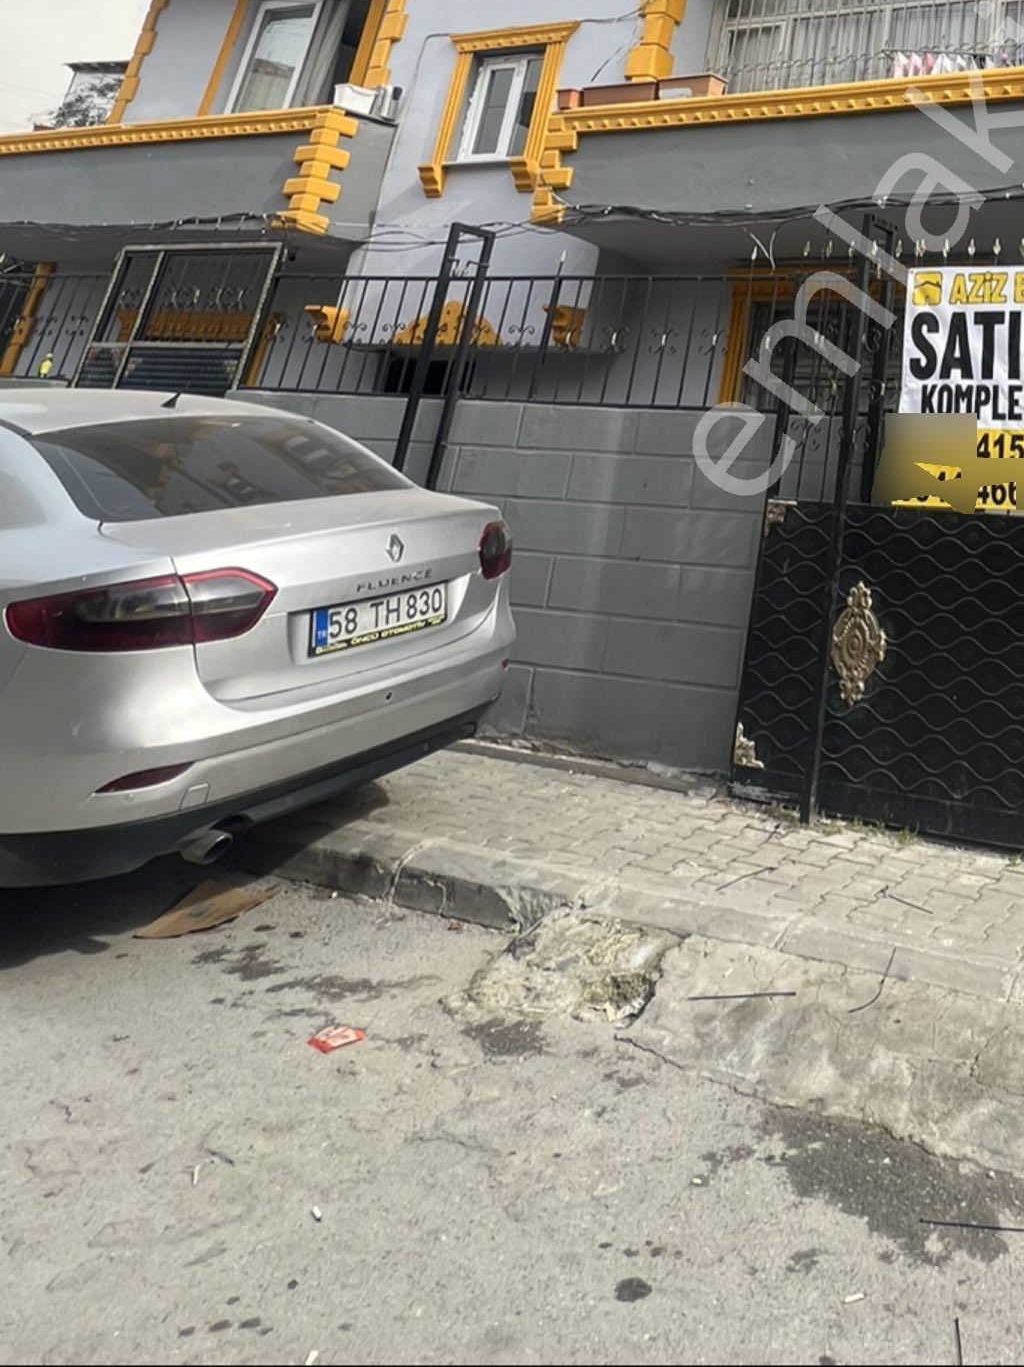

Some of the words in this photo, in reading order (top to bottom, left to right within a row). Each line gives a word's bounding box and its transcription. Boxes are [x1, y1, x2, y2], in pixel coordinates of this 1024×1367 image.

[920, 384, 1023, 421] KOMPLE
[977, 433, 1024, 458] 415
[356, 568, 432, 592] FLUENCE
[329, 607, 358, 638] 58
[370, 597, 401, 629] TH
[406, 588, 443, 620] 830
